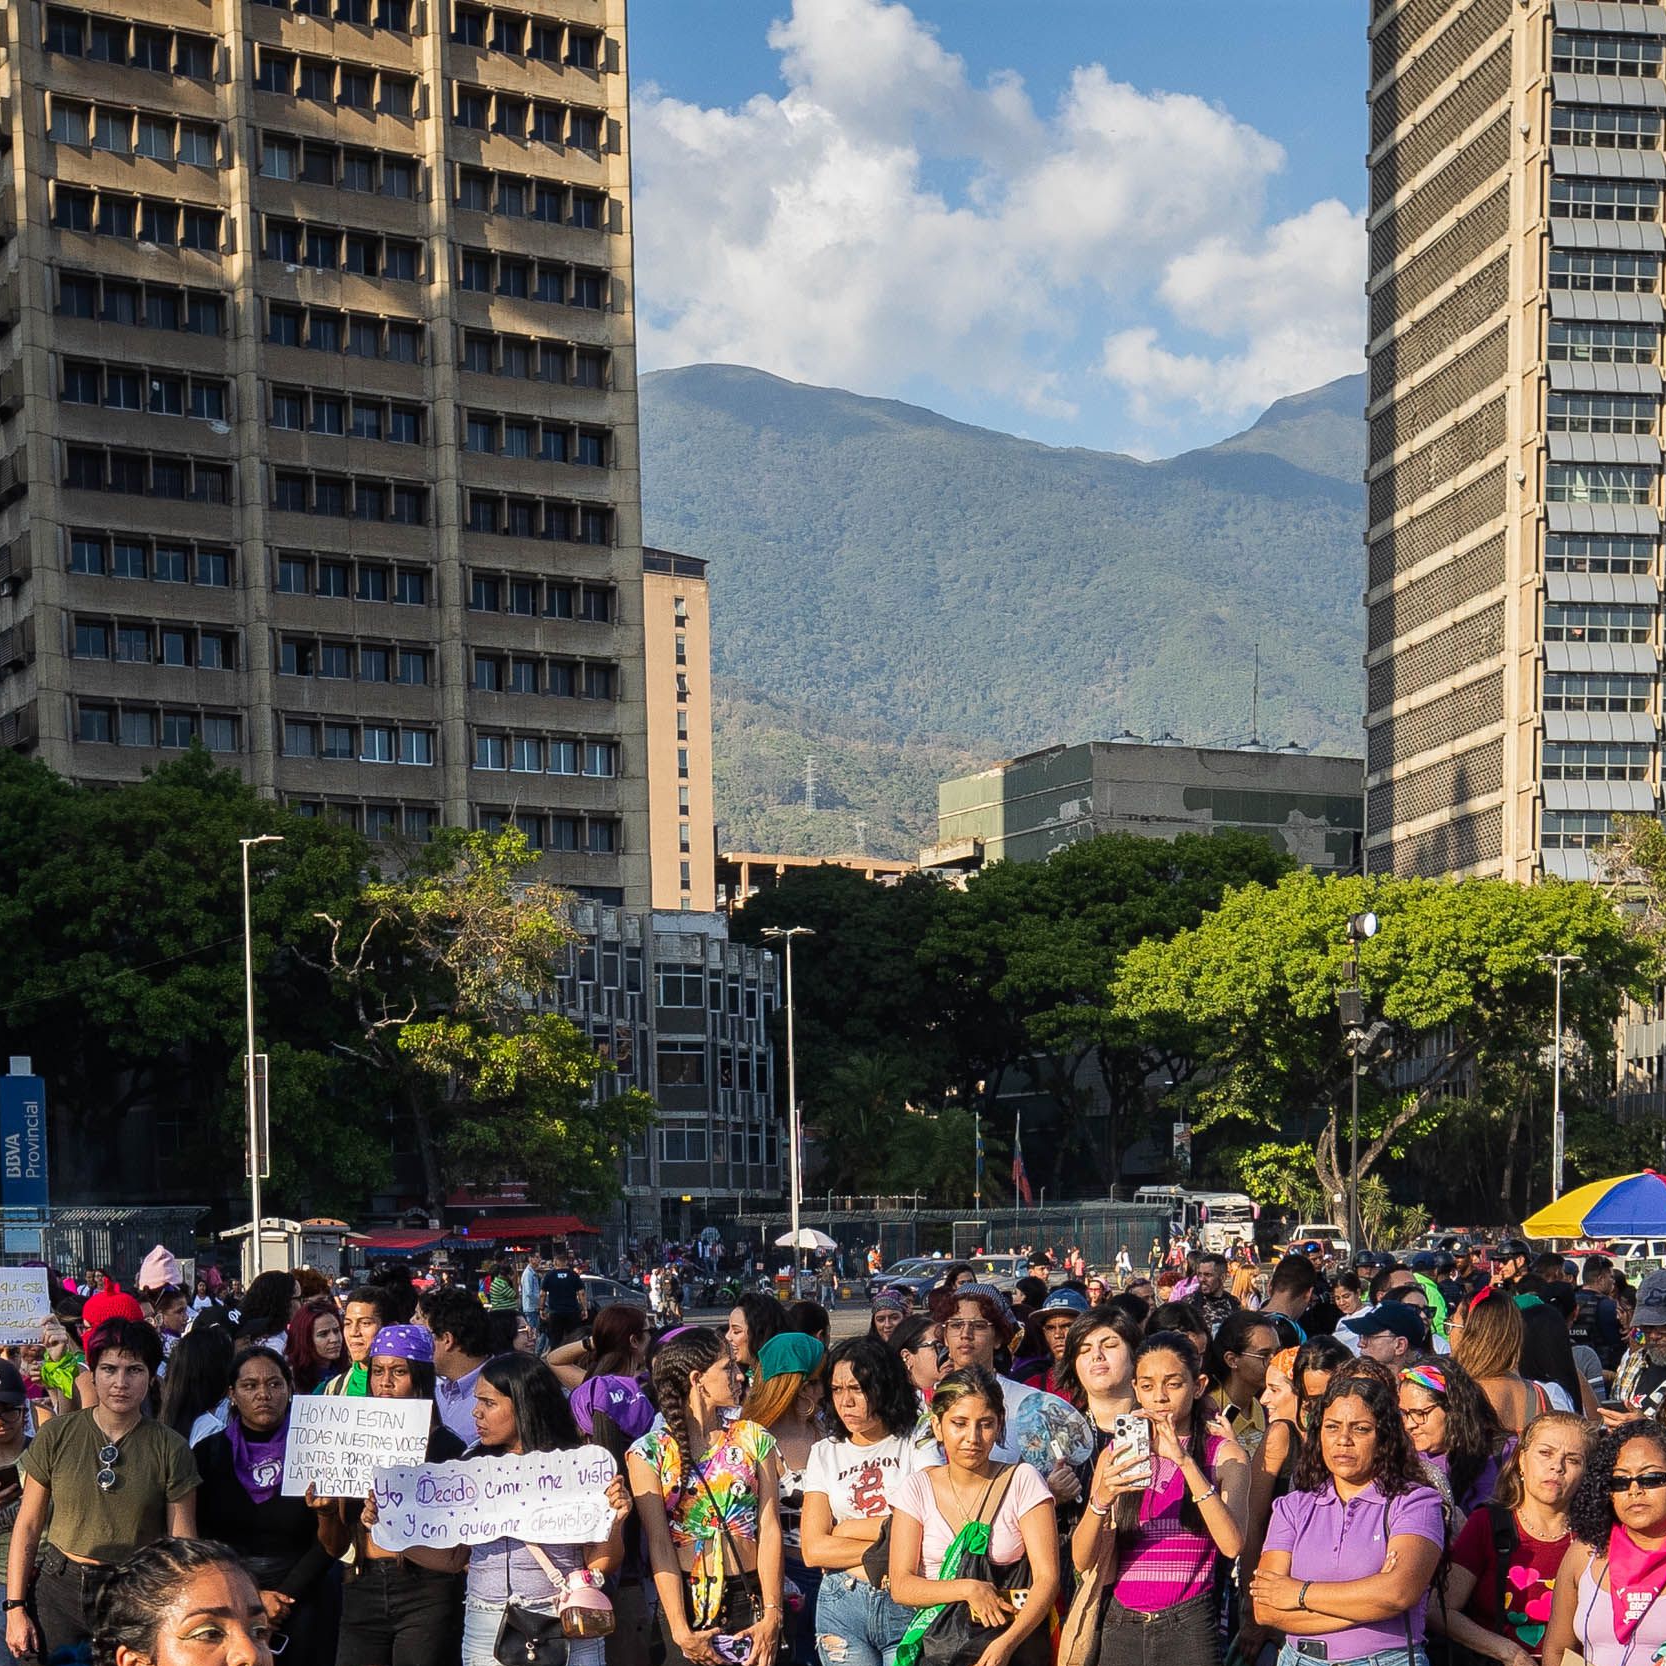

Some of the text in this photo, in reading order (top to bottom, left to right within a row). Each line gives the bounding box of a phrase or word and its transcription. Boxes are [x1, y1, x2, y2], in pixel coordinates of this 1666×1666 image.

[23, 1101, 41, 1178] Provincial
[5, 1134, 22, 1178] BBVA
[300, 1403, 405, 1429] HOY NO ESTAN
[291, 1427, 427, 1452] TODAS NUESTRAS VOCES
[292, 1451, 384, 1466] JUNTAS PORQUE
[837, 1457, 901, 1481] DRAGON
[342, 1467, 358, 1479] NO
[422, 1520, 520, 1542] con quien me
